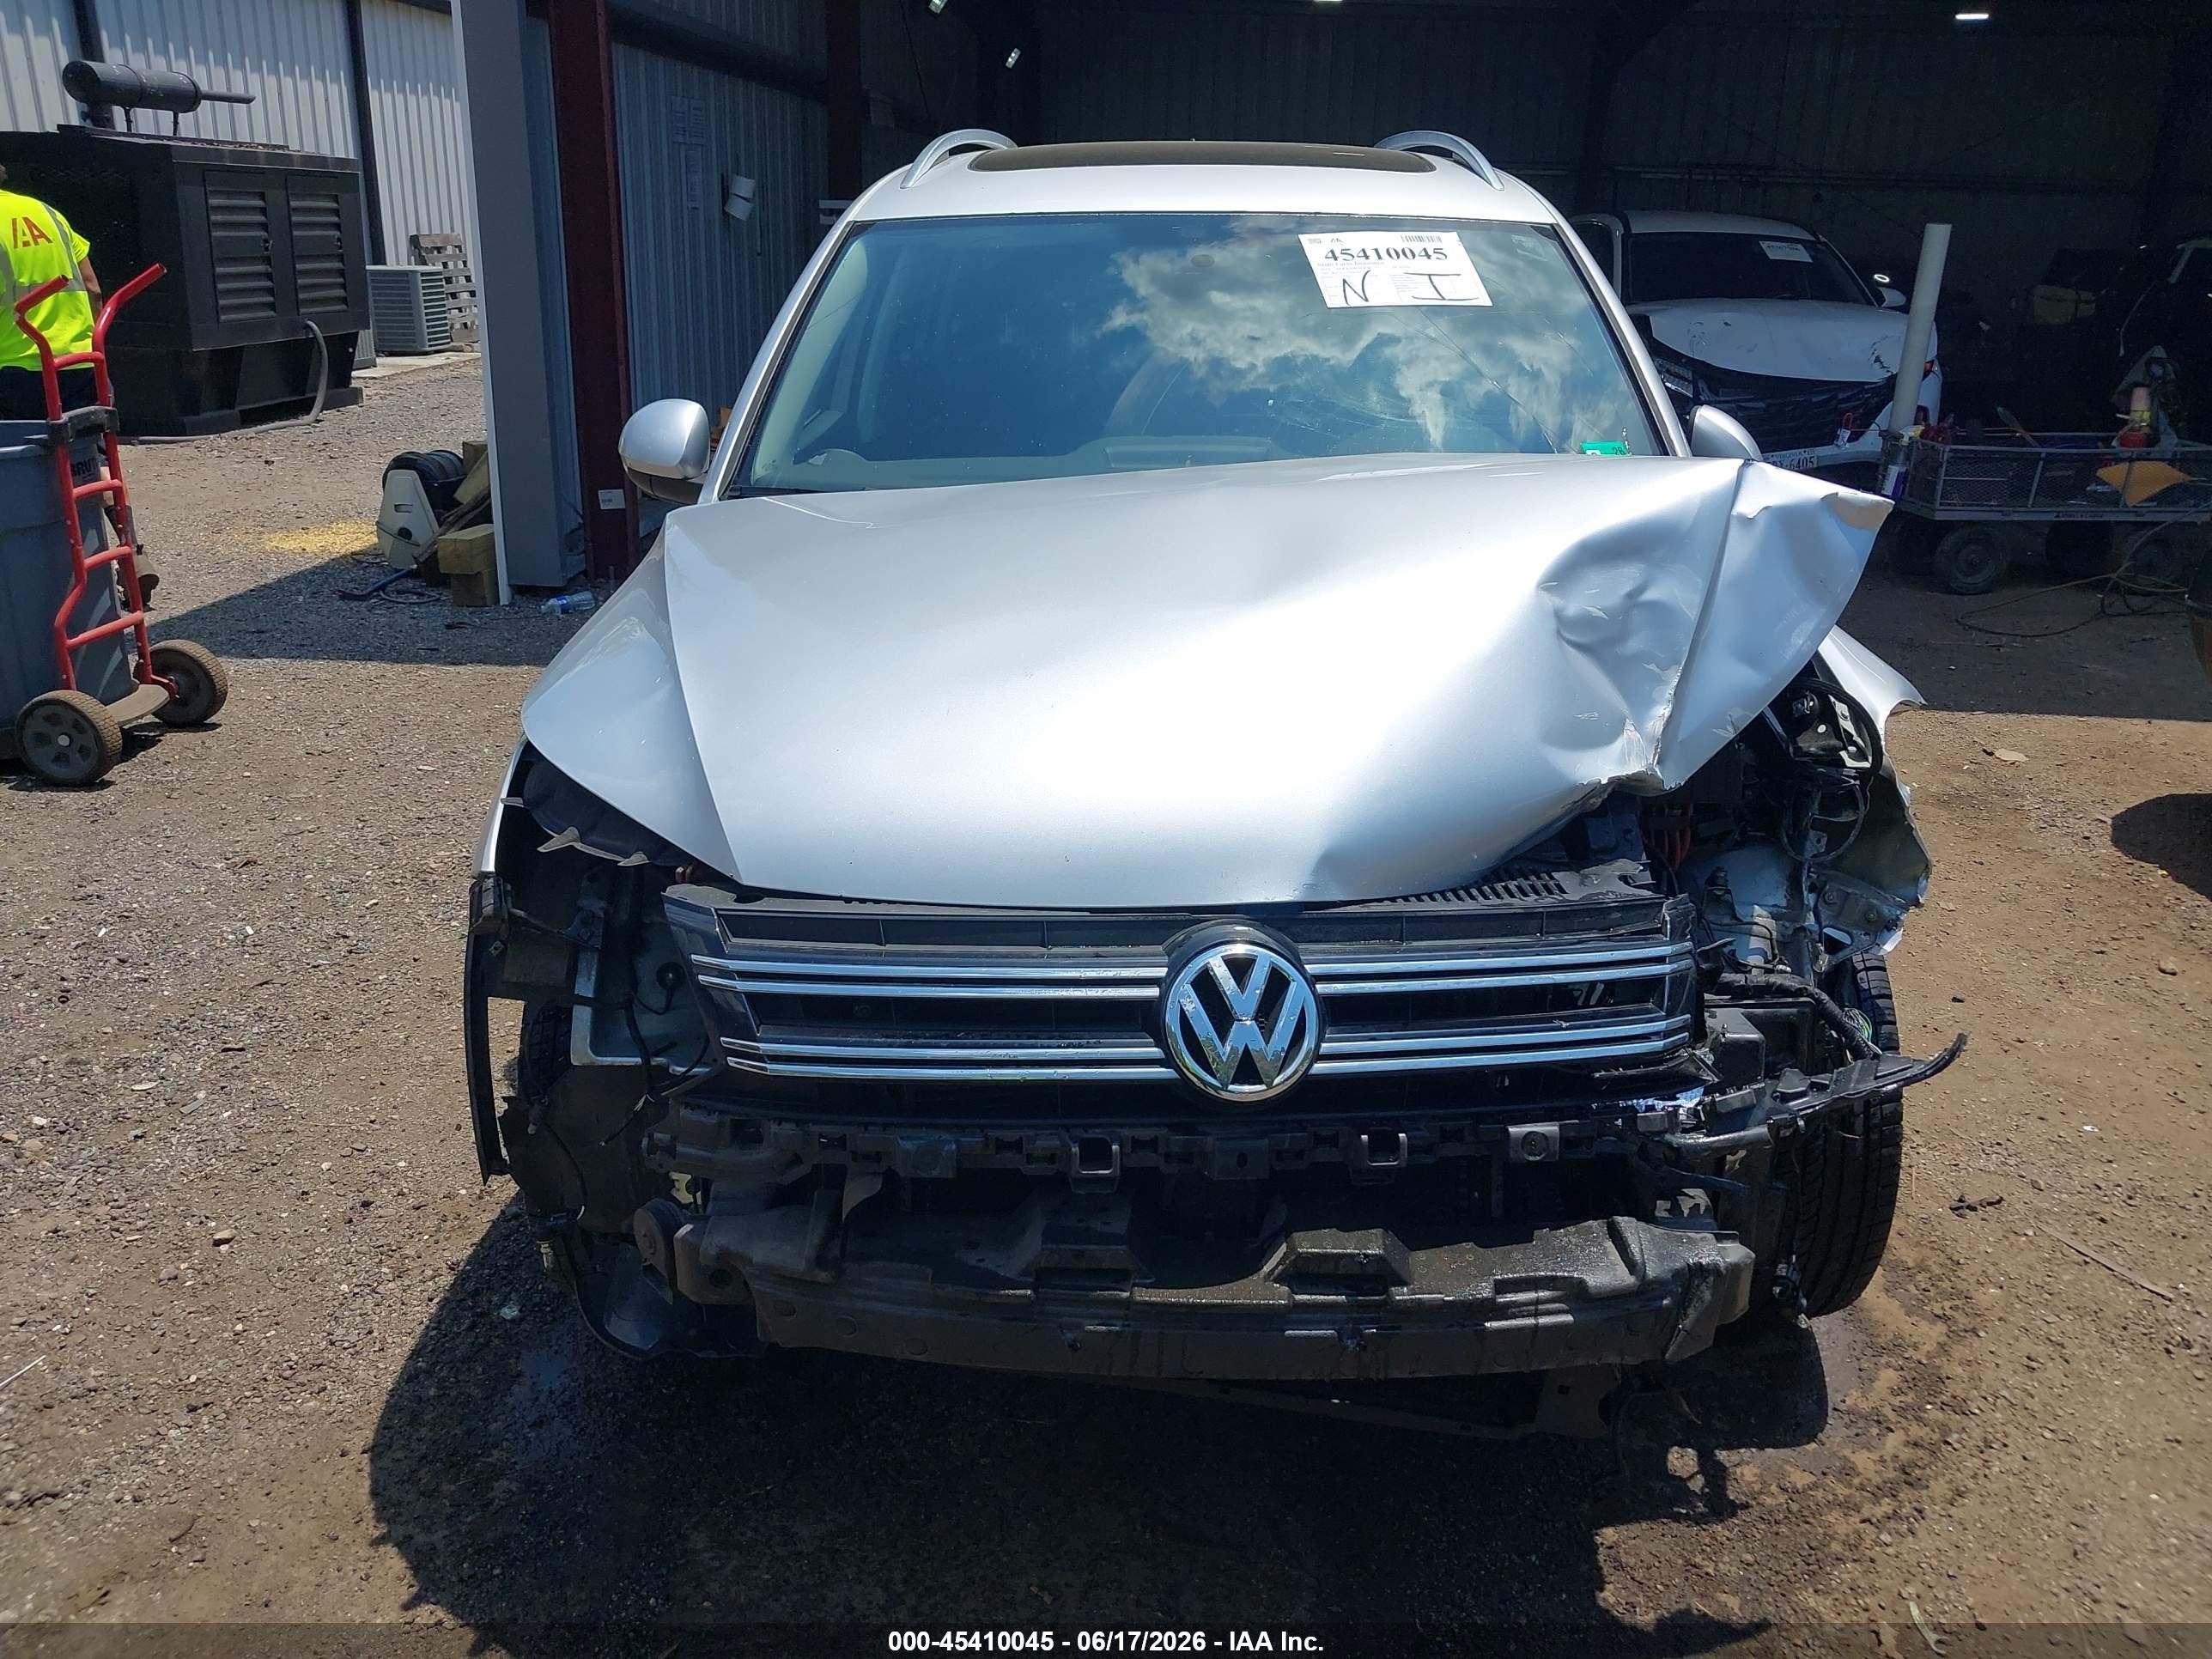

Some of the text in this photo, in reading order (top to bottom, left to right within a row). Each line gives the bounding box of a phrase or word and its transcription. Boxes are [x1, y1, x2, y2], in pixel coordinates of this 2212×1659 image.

[1324, 246, 1449, 262] 45410045
[1342, 270, 1371, 307] N
[1171, 948, 1314, 1096] VW
